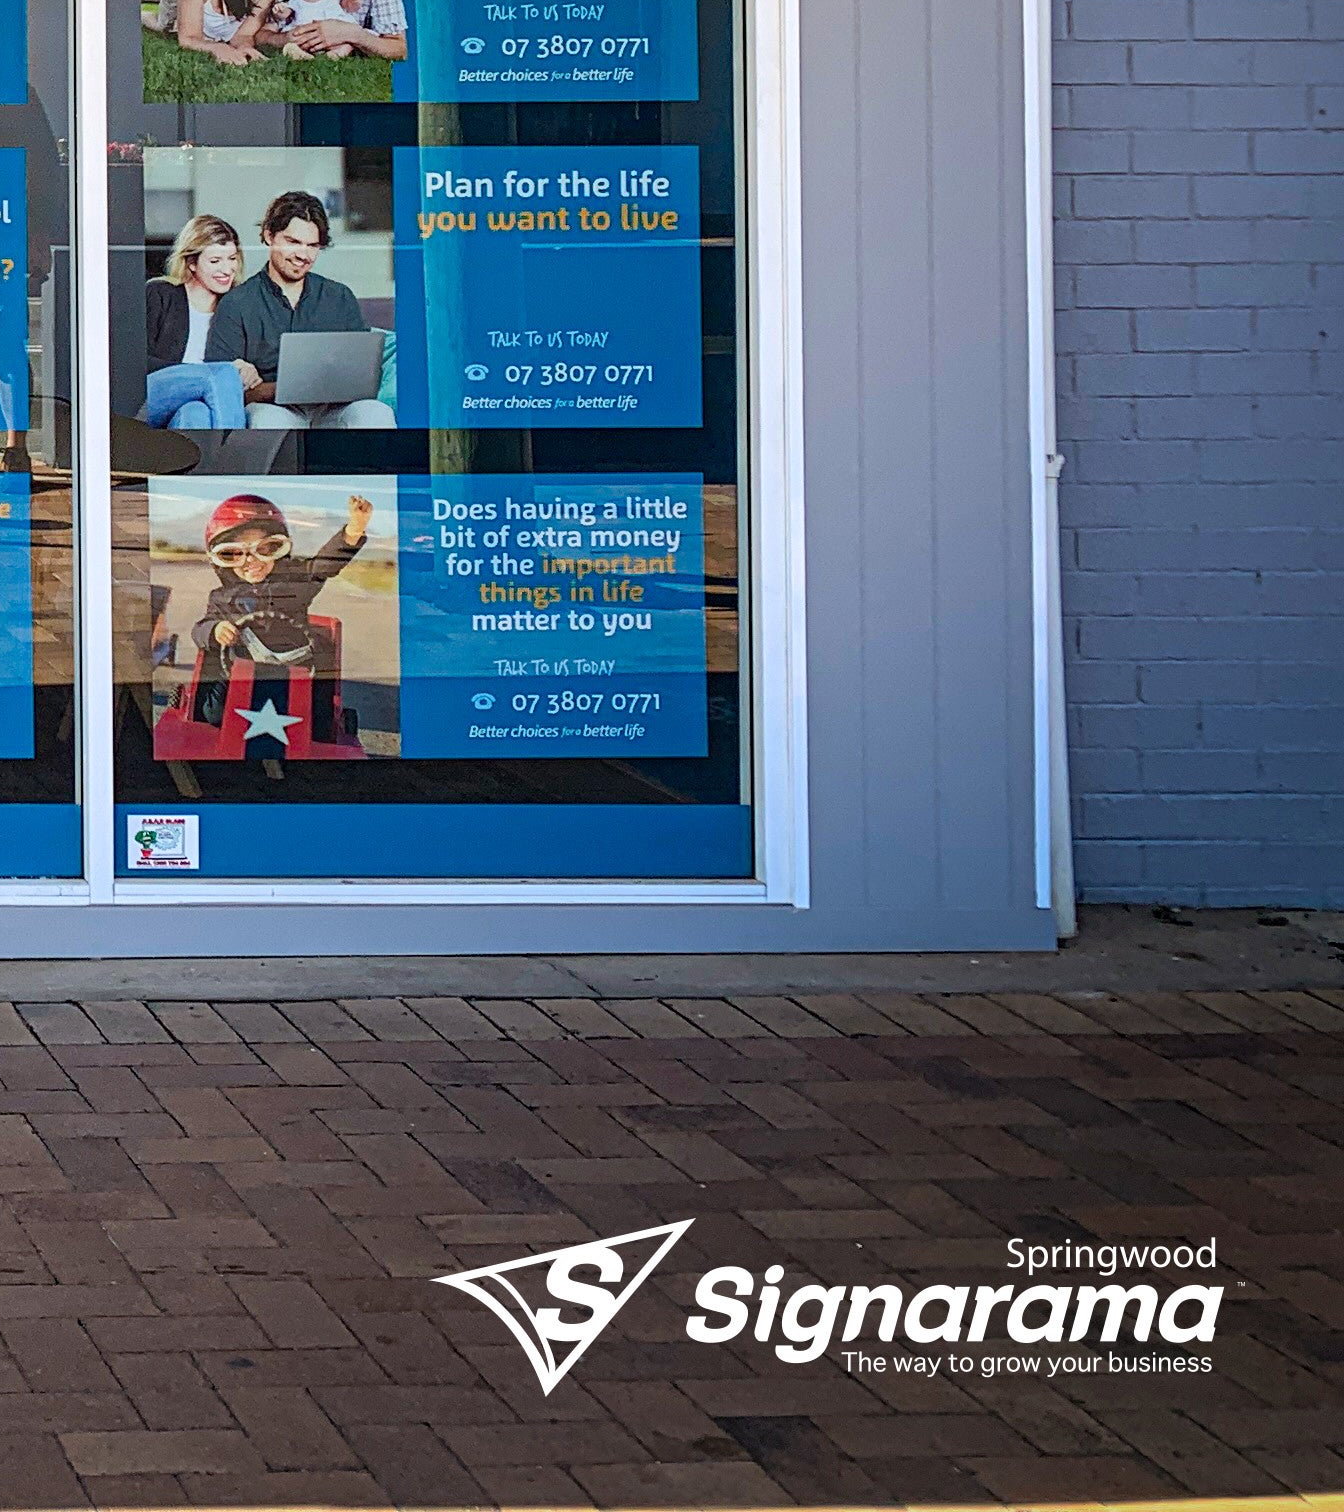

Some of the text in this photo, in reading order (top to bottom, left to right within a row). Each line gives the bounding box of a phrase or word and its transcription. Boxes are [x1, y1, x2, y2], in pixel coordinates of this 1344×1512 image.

[502, 36, 648, 58] 07 3807 0771
[426, 170, 669, 197] Plan for the life
[418, 204, 677, 239] you want to live
[506, 363, 652, 385] 07 3807 0771
[434, 496, 687, 526] Does having a little
[441, 525, 680, 552] bit of extra money
[446, 553, 676, 579] for the important
[480, 580, 643, 609] things in life
[473, 611, 651, 636] matter to you
[494, 659, 615, 676] TALK TO US TODAY
[513, 691, 659, 714] 07 3807 0771
[469, 724, 645, 739] Better choices better life
